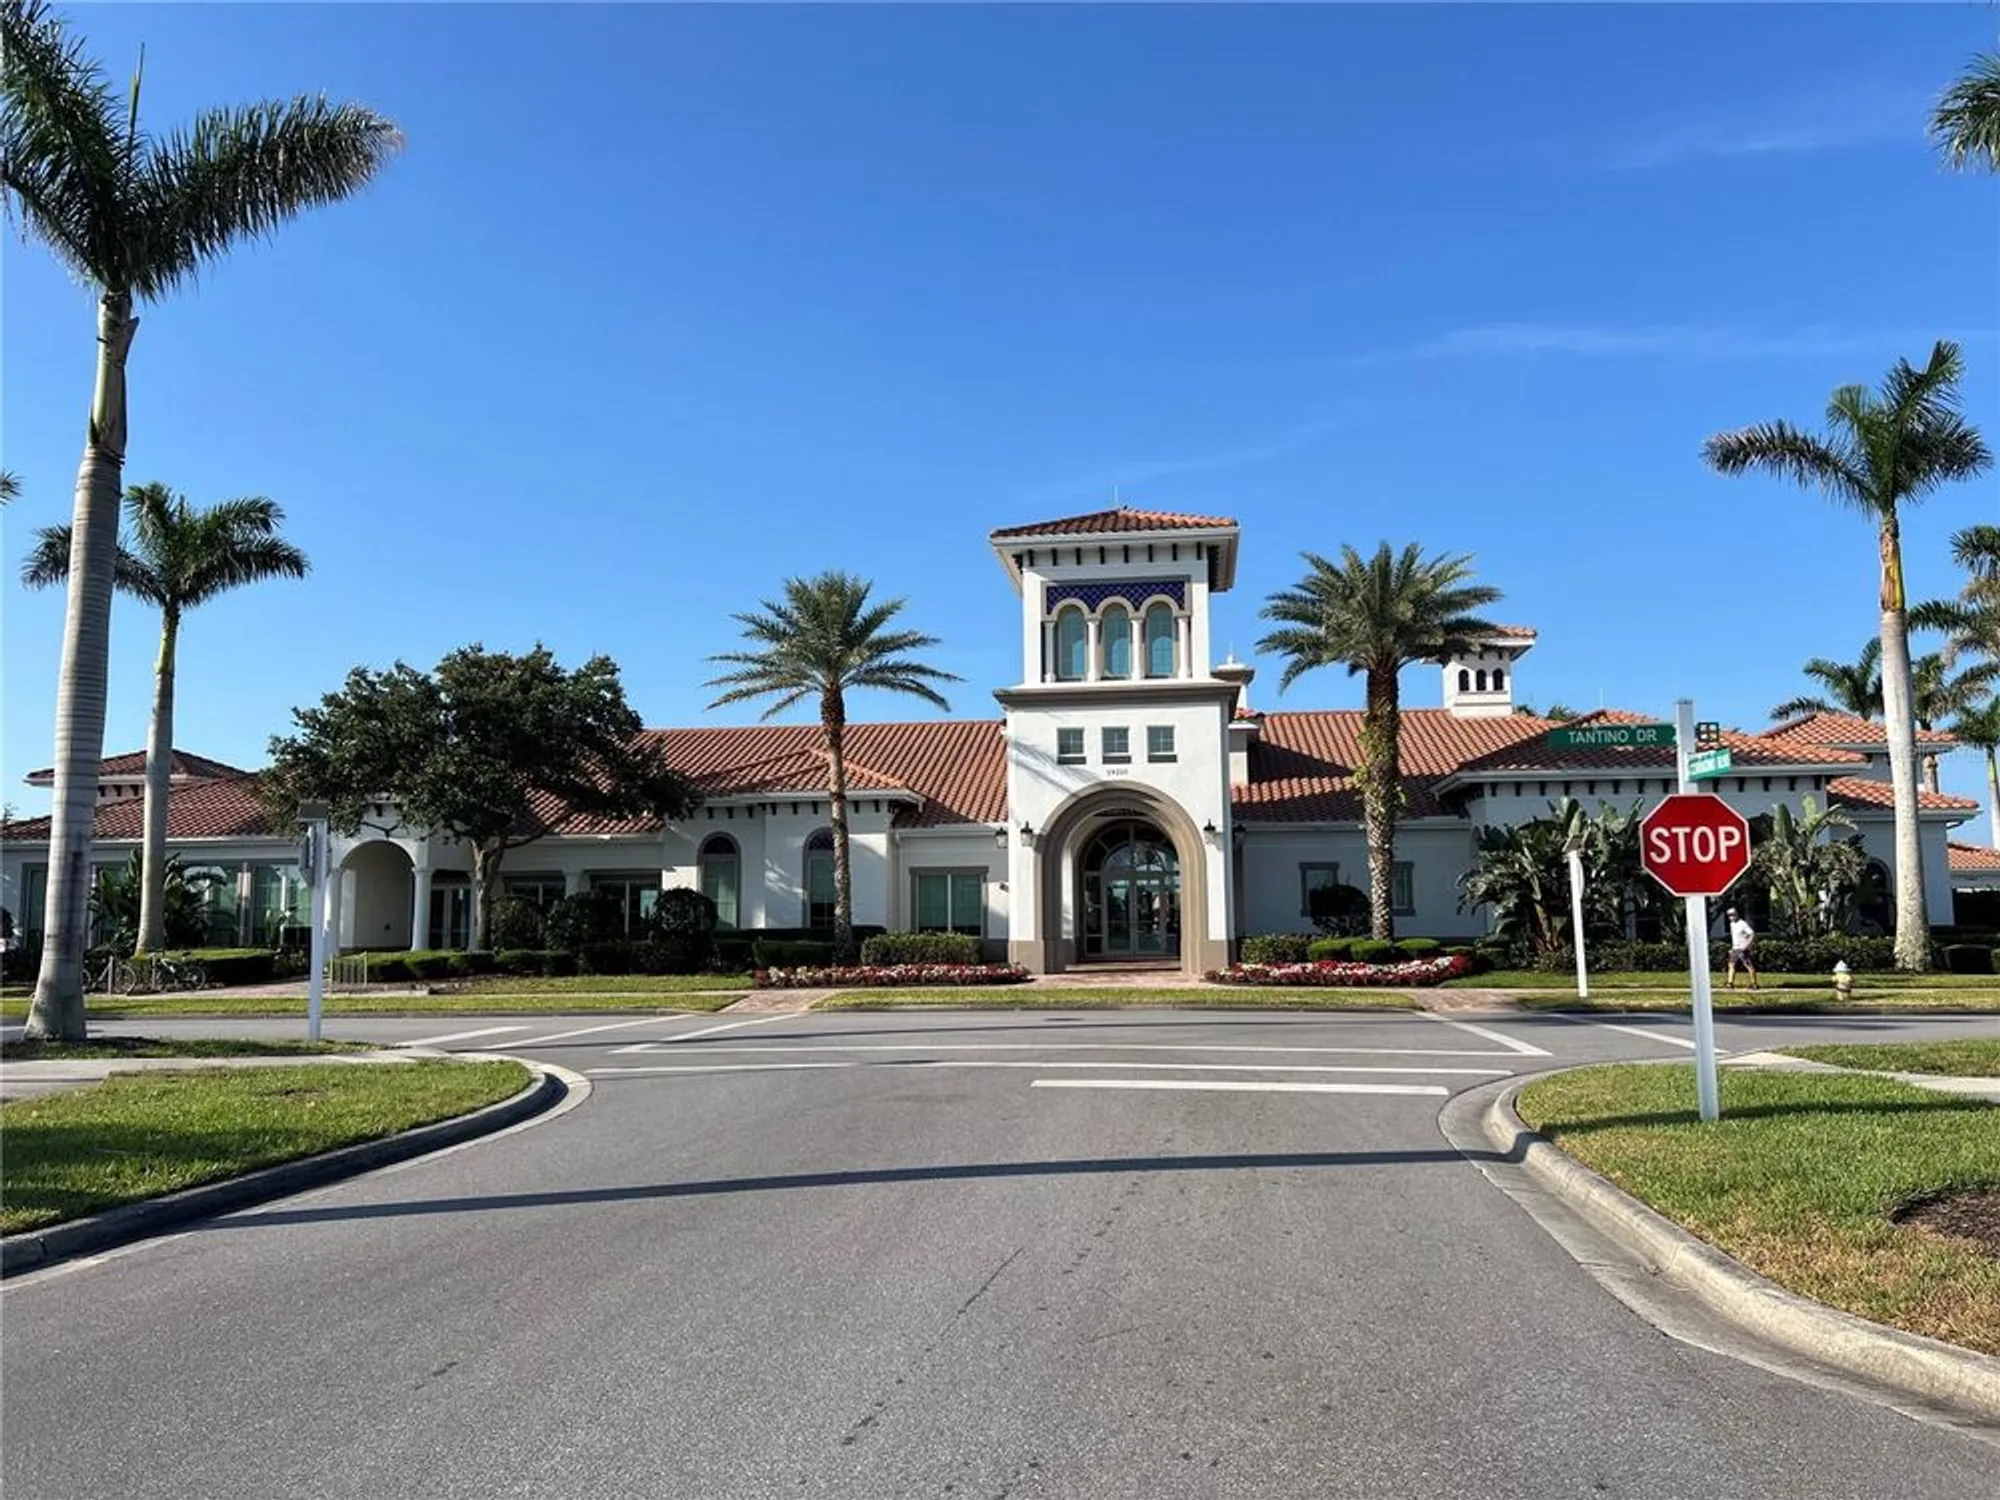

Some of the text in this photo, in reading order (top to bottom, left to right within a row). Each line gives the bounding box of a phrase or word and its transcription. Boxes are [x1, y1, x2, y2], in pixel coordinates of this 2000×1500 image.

[1568, 728, 1658, 743] TANTINO DR
[1650, 826, 1741, 864] STOP
